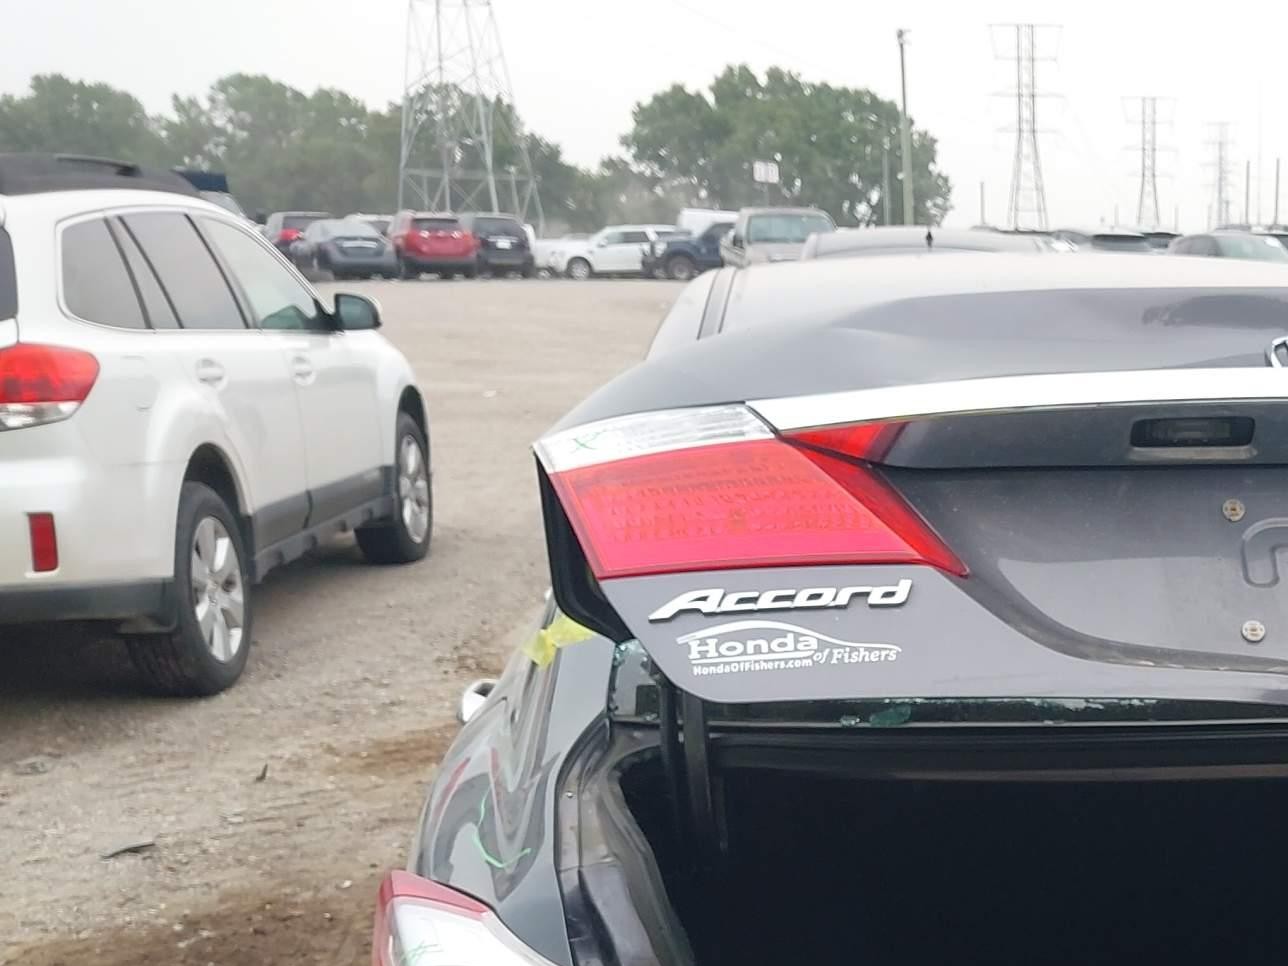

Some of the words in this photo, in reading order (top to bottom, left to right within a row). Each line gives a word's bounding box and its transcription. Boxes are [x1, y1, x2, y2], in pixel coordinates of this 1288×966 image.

[648, 579, 913, 622] Accord
[688, 633, 818, 660] Honda
[812, 649, 830, 664] of
[830, 647, 897, 664] Fishers
